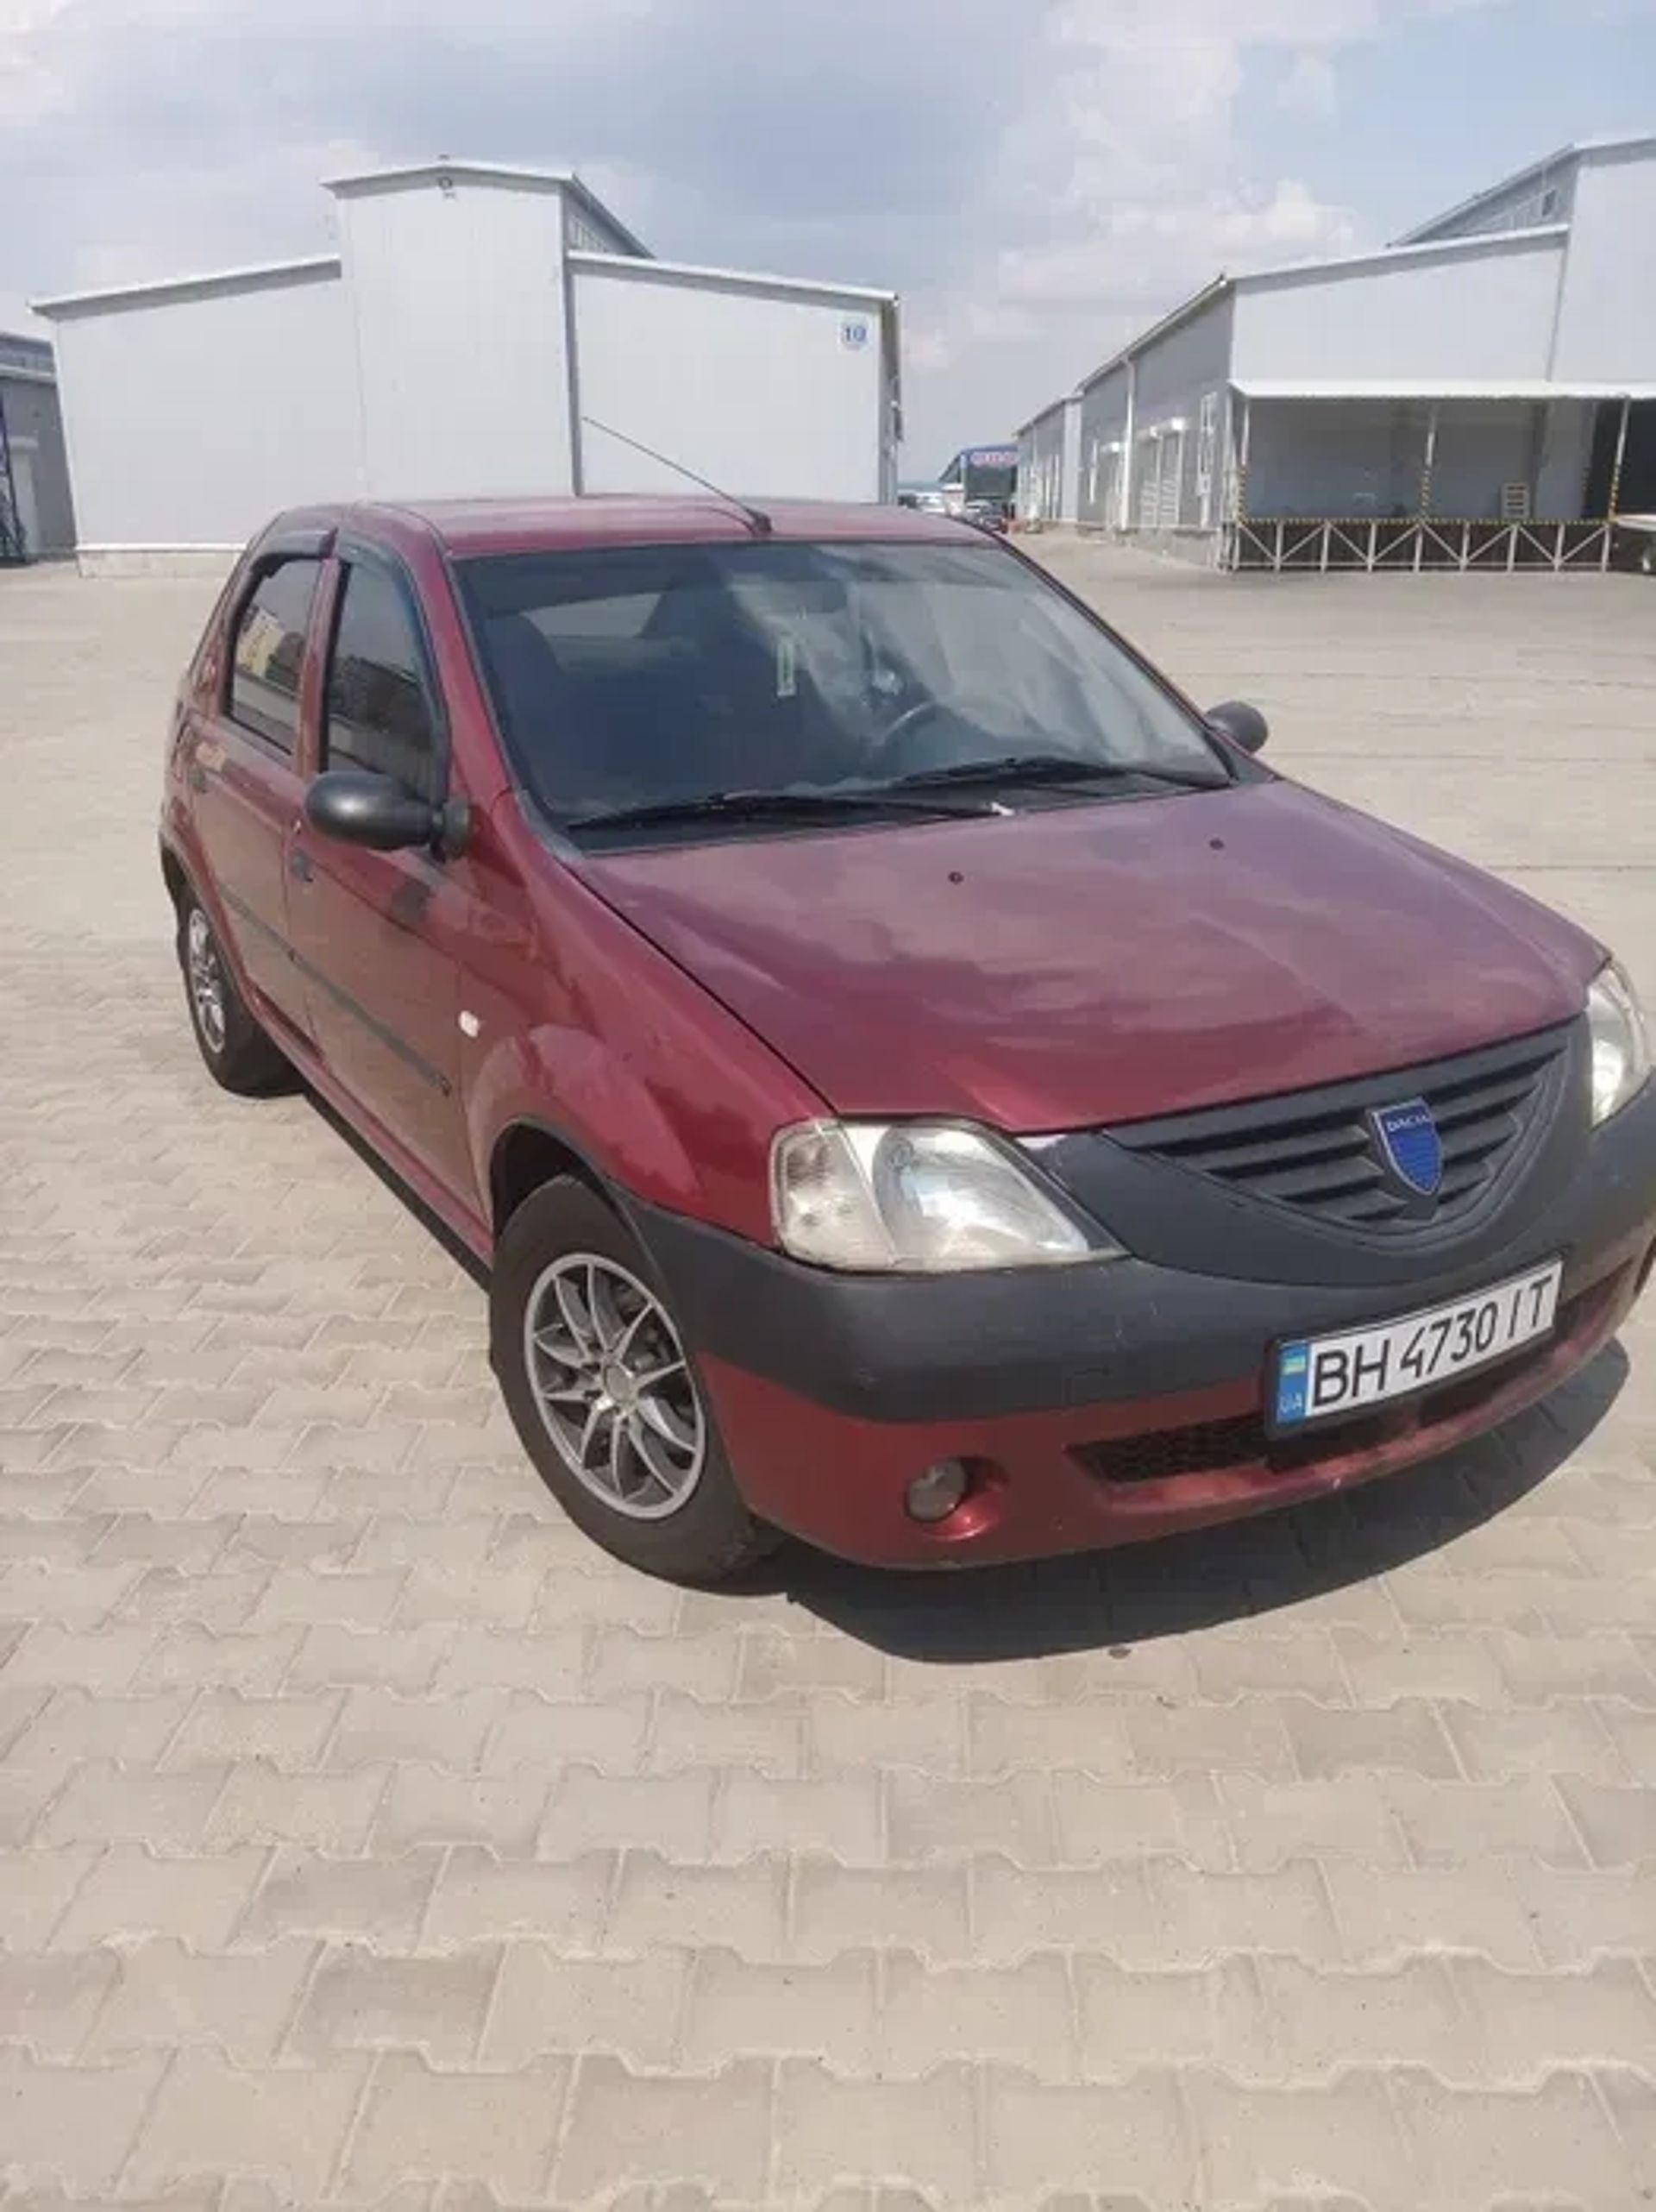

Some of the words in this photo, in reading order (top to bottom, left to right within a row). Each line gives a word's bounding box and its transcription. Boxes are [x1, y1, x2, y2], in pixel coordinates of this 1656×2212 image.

[1386, 1114, 1431, 1132] DACIA
[1314, 1338, 1391, 1408] BH
[1399, 1300, 1499, 1379] 4730
[1508, 1275, 1552, 1339] IT
[1279, 1392, 1303, 1413] UA
